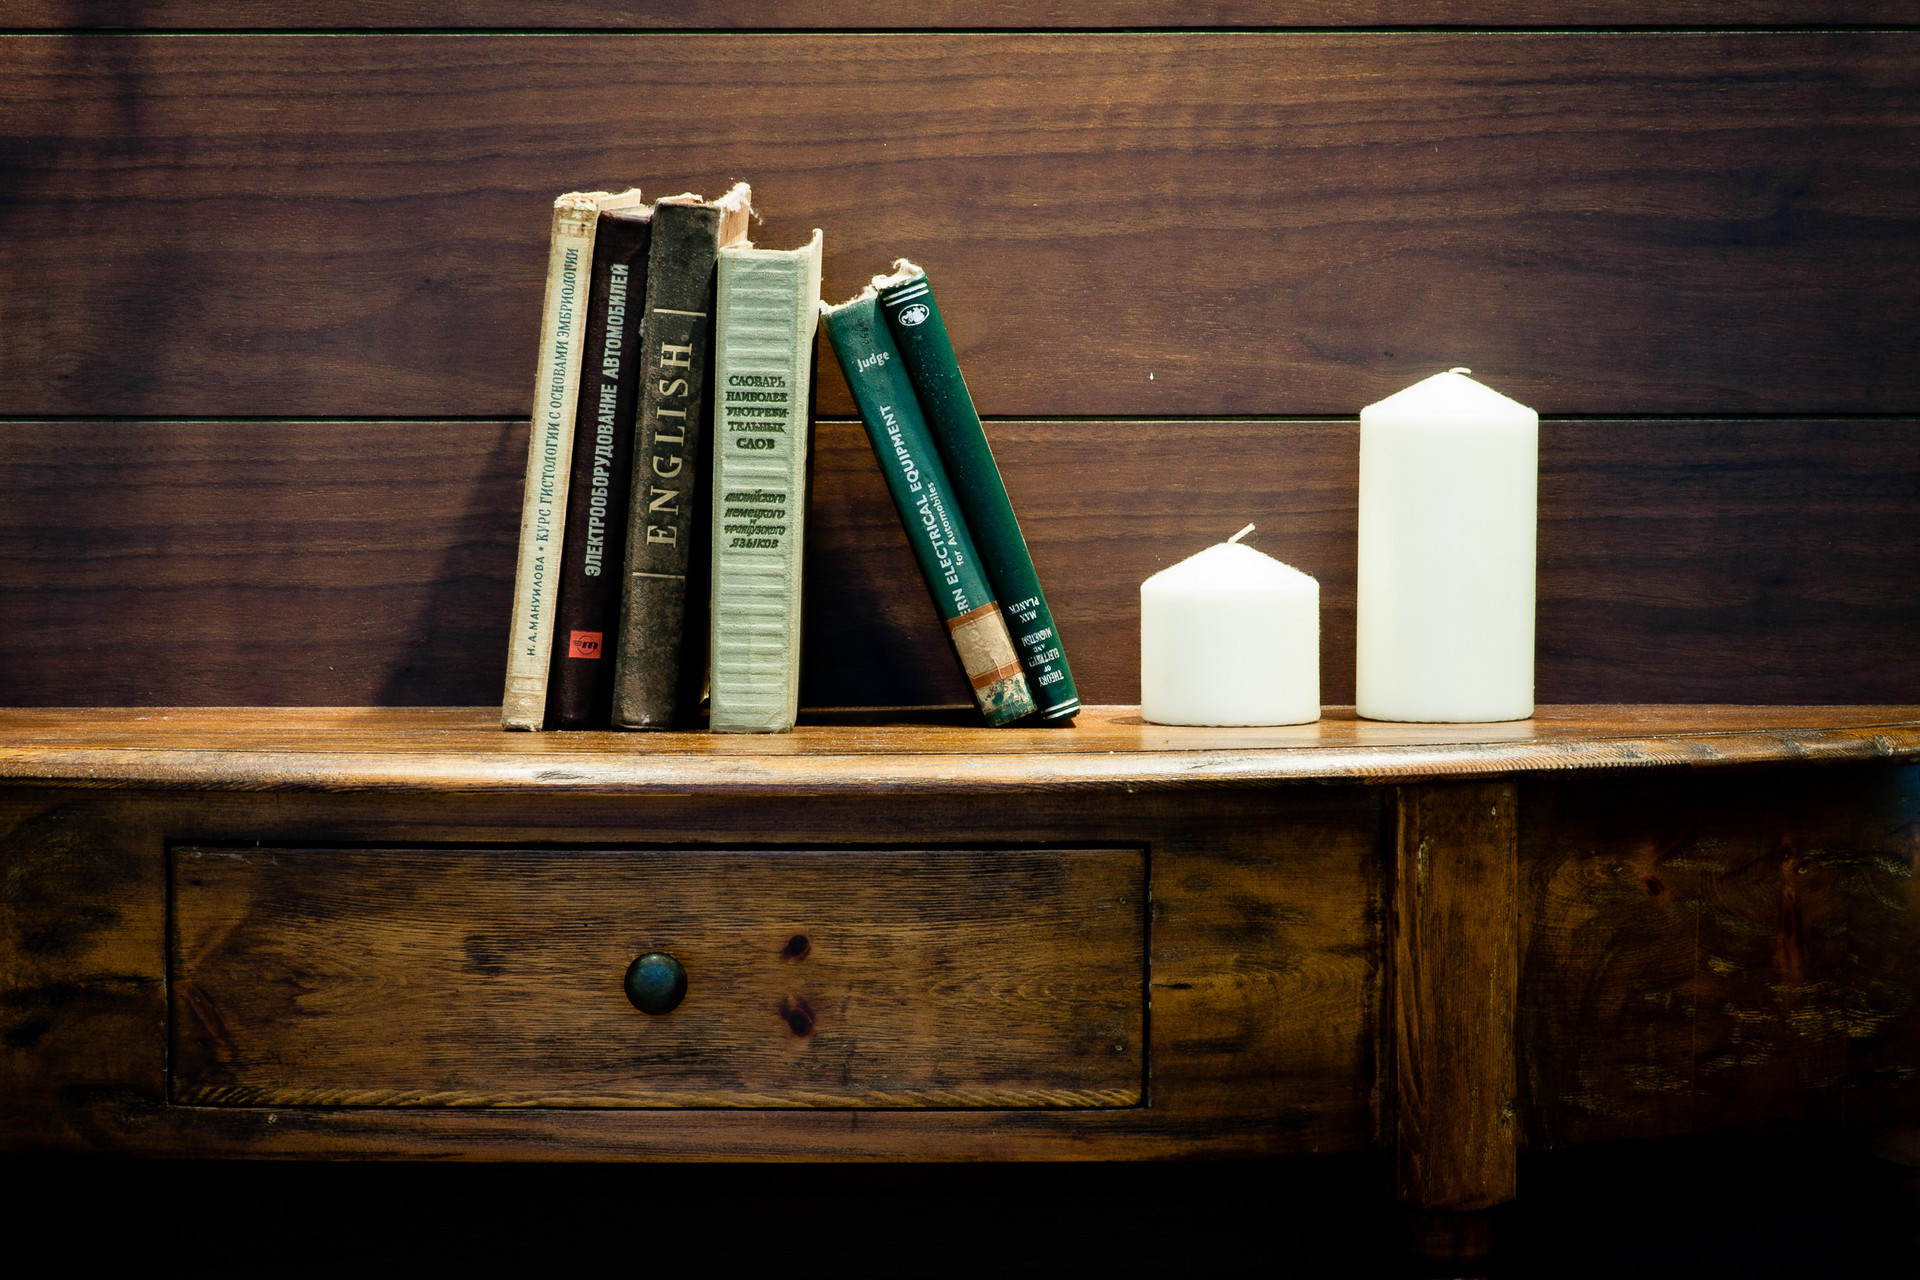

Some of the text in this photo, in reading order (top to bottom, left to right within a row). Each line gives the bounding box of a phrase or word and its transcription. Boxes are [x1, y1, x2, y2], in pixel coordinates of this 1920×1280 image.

[556, 247, 579, 338] ЭМБРИОЛОГИИ
[549, 340, 568, 409] ОСНОВАМИ
[728, 375, 786, 388] СЛОВАРЬ
[857, 351, 890, 373] Judge
[584, 263, 629, 577] ЭЛЕКТРООБОРУДОВАНИЕ АВТОМОБИЛЕЙ
[725, 391, 788, 402] НАИБОЛЕЕ
[647, 341, 693, 548] ENGLISH
[727, 421, 786, 434] ТЕЛЬНЫХ
[736, 438, 775, 450] СЛОВ
[879, 405, 922, 493] EQUIPMENT
[539, 422, 560, 505] ГИСТОЛОГИИ
[535, 508, 551, 543] КУРС
[916, 494, 959, 586] ELECTRICAL
[927, 481, 965, 567] for Automobiles
[528, 556, 544, 631] МАНУИЛОВА
[1008, 596, 1040, 615] PLANCK
[1019, 609, 1038, 624] MAX
[1038, 669, 1064, 687] THEORY
